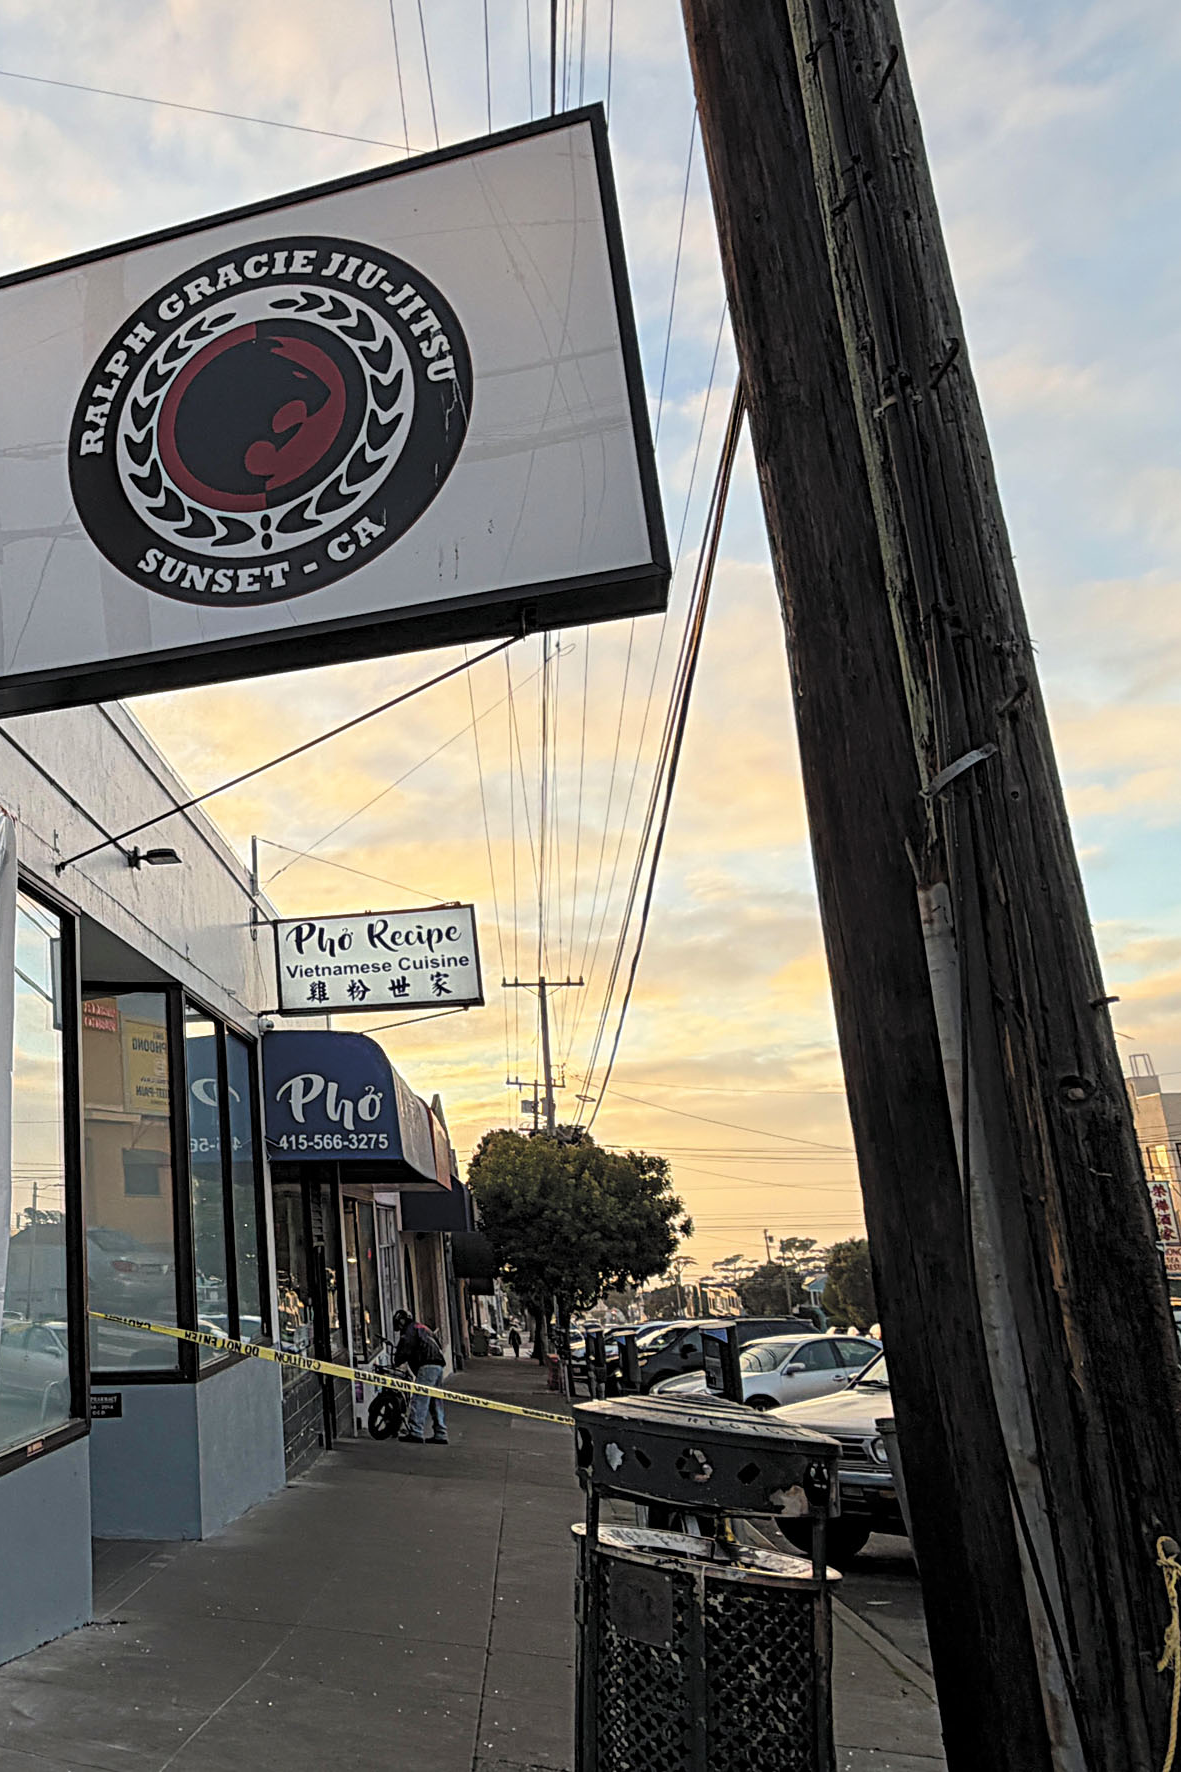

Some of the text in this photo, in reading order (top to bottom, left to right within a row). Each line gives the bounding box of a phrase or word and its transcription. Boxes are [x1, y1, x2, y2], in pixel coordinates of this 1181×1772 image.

[79, 249, 456, 456] RALPH GRACIE JIU-JITSU
[137, 547, 290, 595] SUNSET
[327, 515, 386, 562] CA
[285, 919, 462, 957] Phở Recipe
[286, 955, 470, 979] Vietnamese Cuisine
[306, 971, 453, 1004] 雞粉世家
[276, 1073, 383, 1131] Phở
[279, 1133, 389, 1150] 415-566-3275
[221, 1338, 241, 1352] NOT
[245, 1344, 260, 1357] DO
[274, 1352, 321, 1370] CAUTION
